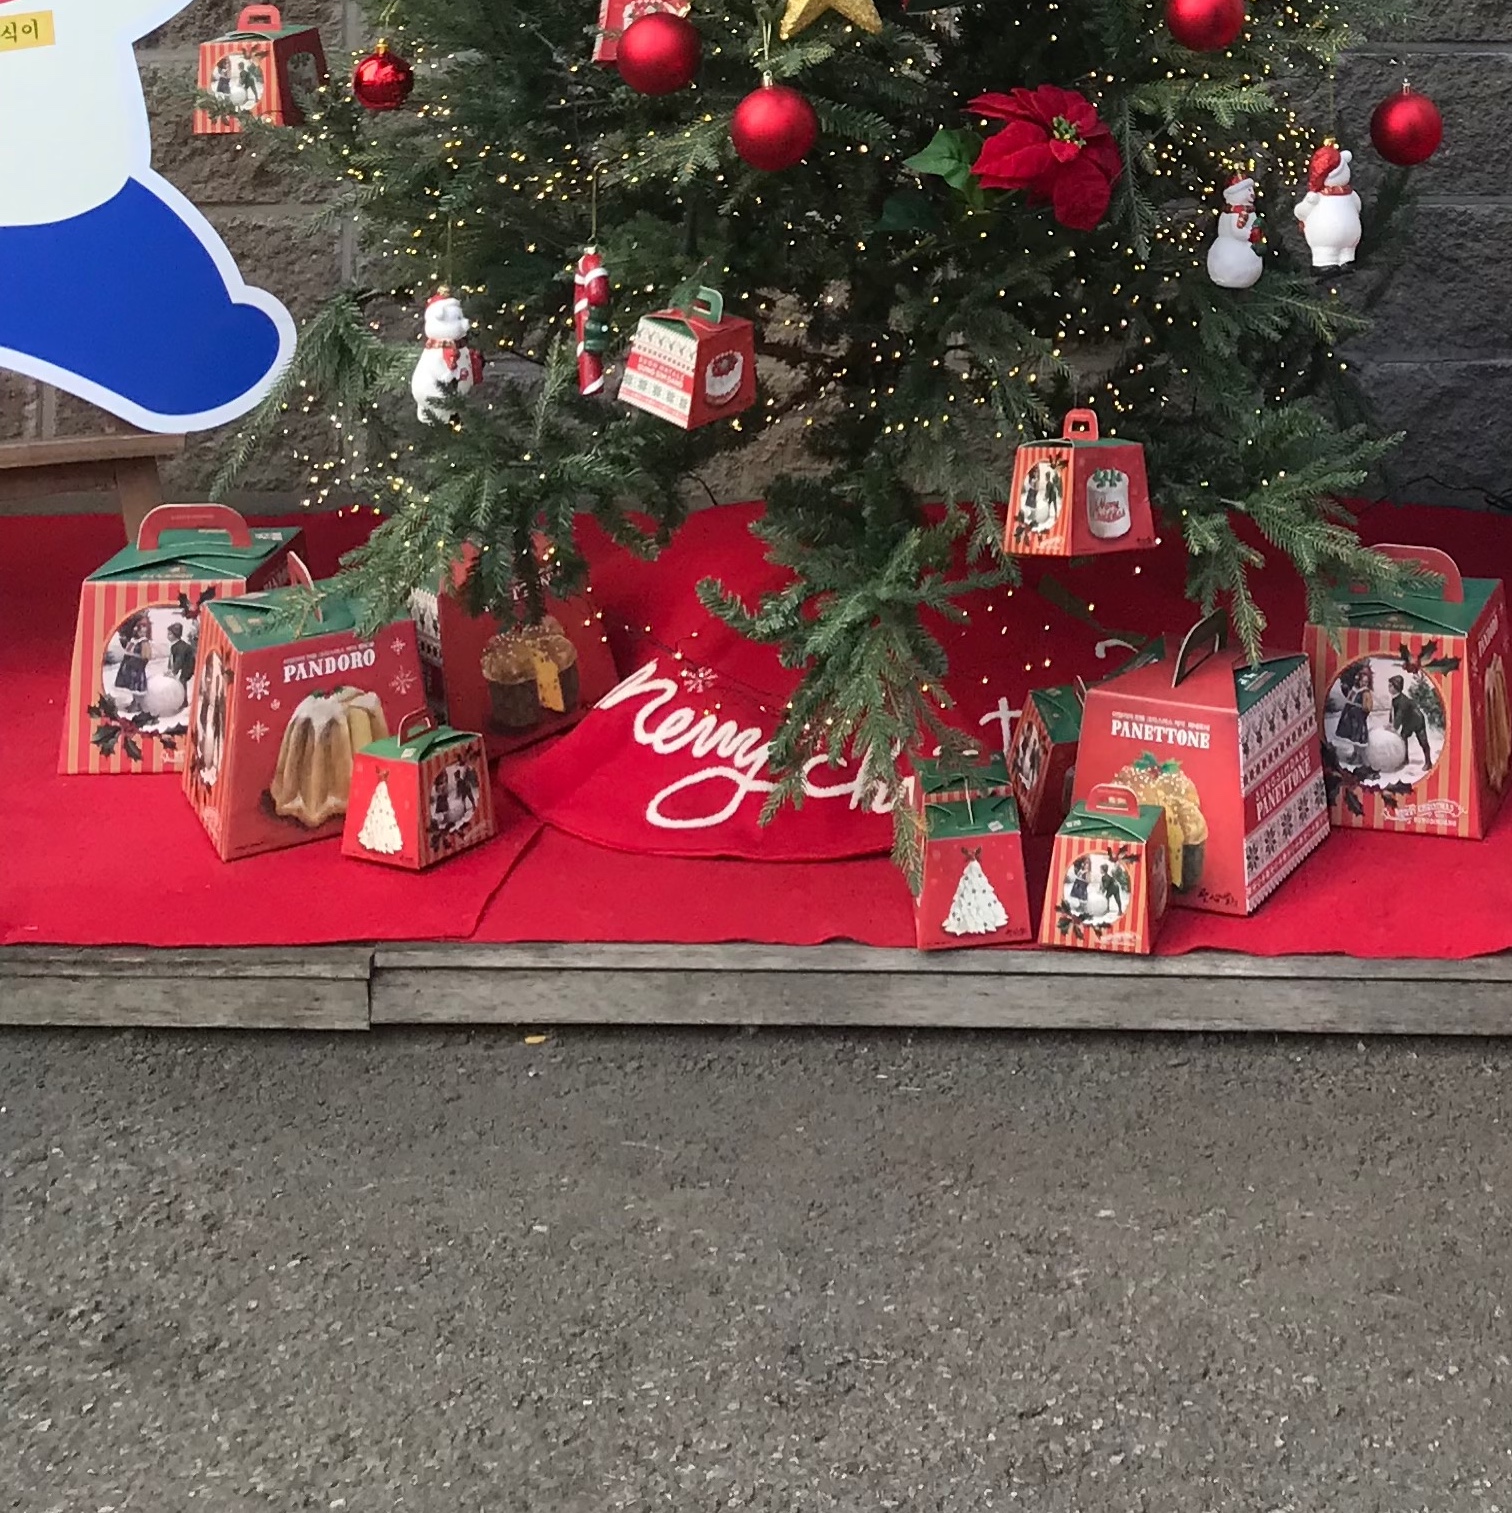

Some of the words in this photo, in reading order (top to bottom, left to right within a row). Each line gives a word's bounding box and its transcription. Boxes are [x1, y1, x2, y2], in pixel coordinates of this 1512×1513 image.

[283, 648, 376, 683] PANDORO
[1110, 719, 1211, 750] PANETTONE
[1256, 756, 1312, 822] PANETTONE
